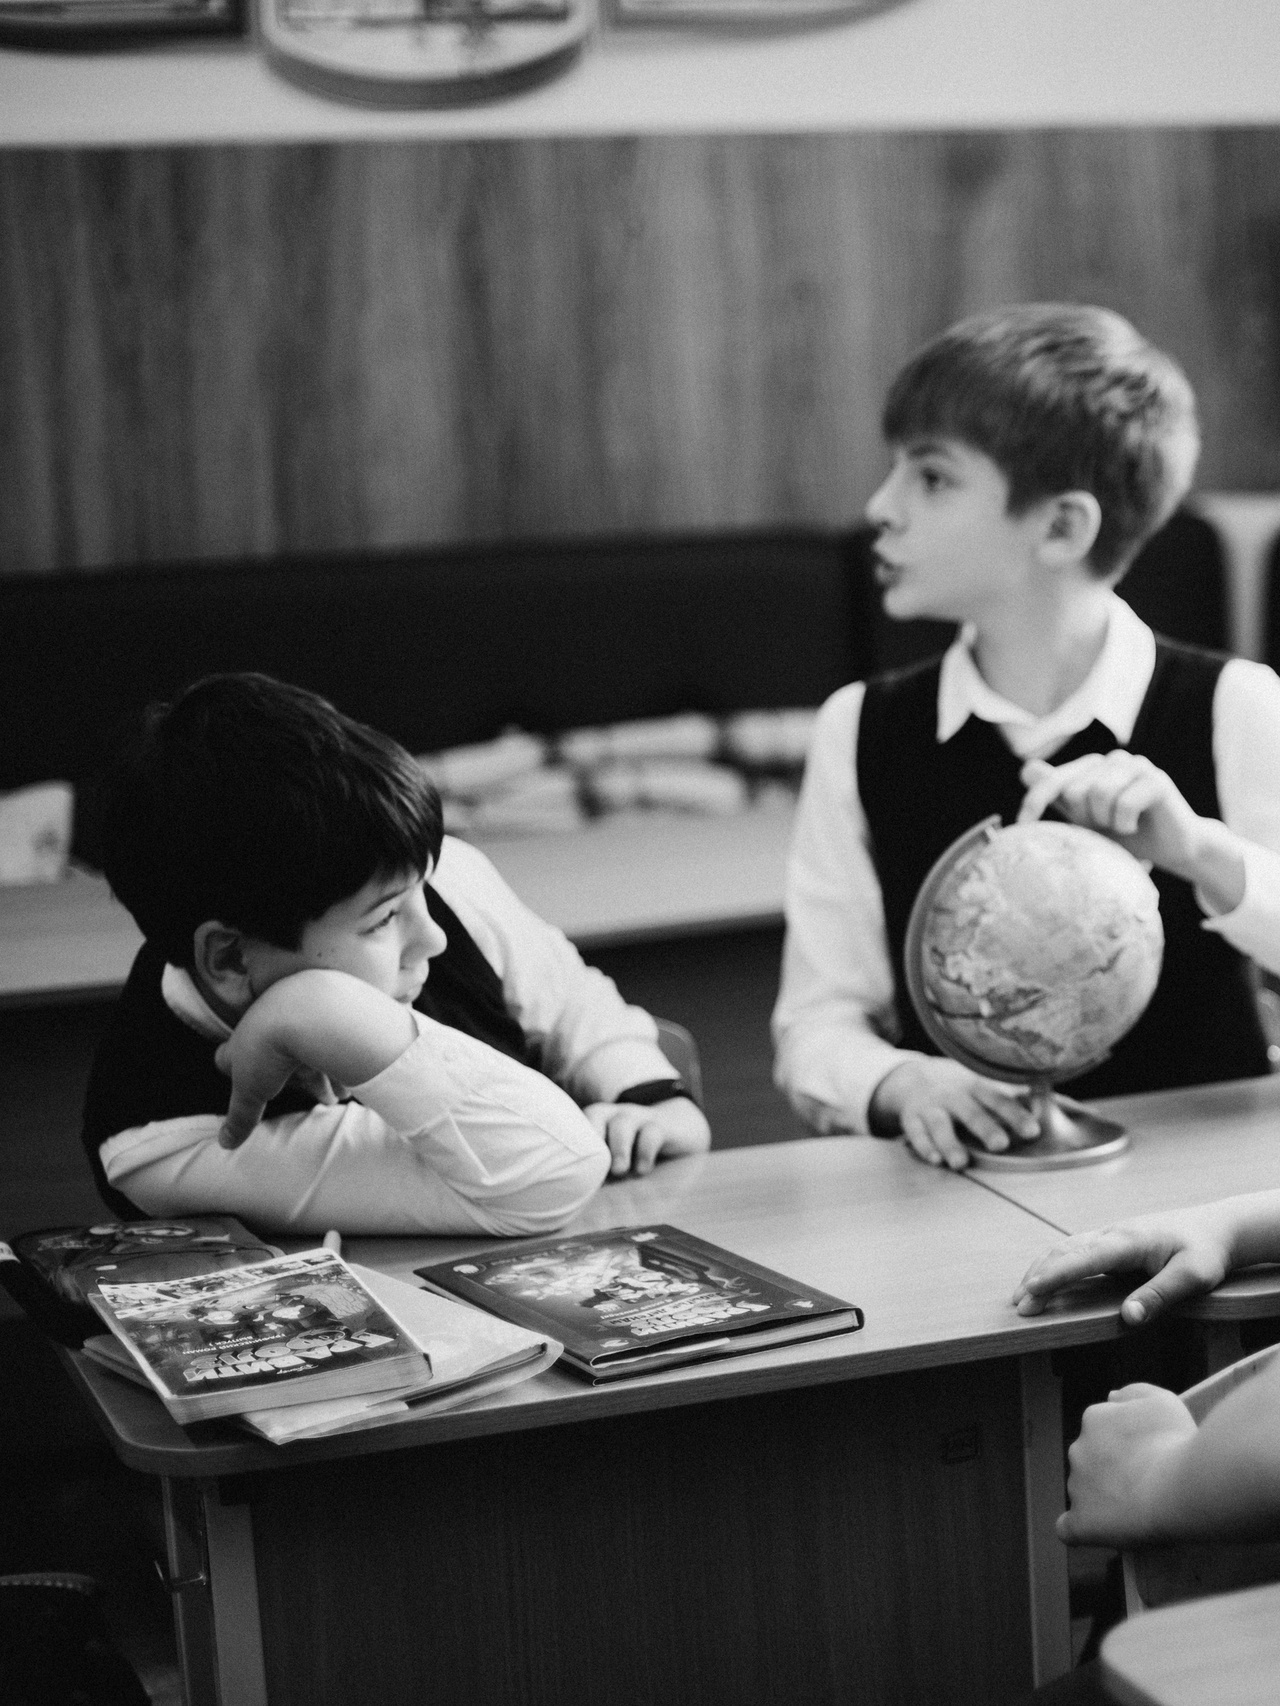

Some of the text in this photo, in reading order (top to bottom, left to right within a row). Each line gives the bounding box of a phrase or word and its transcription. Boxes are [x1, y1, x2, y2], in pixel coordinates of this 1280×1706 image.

[631, 1301, 771, 1336] ГРАВИТИ
[182, 1333, 286, 1355] ГРАФИЧЕСКИЙ РОМАН
[183, 1328, 395, 1382] ГРАВИТИ
[215, 1336, 253, 1346] ВЫПУСК
